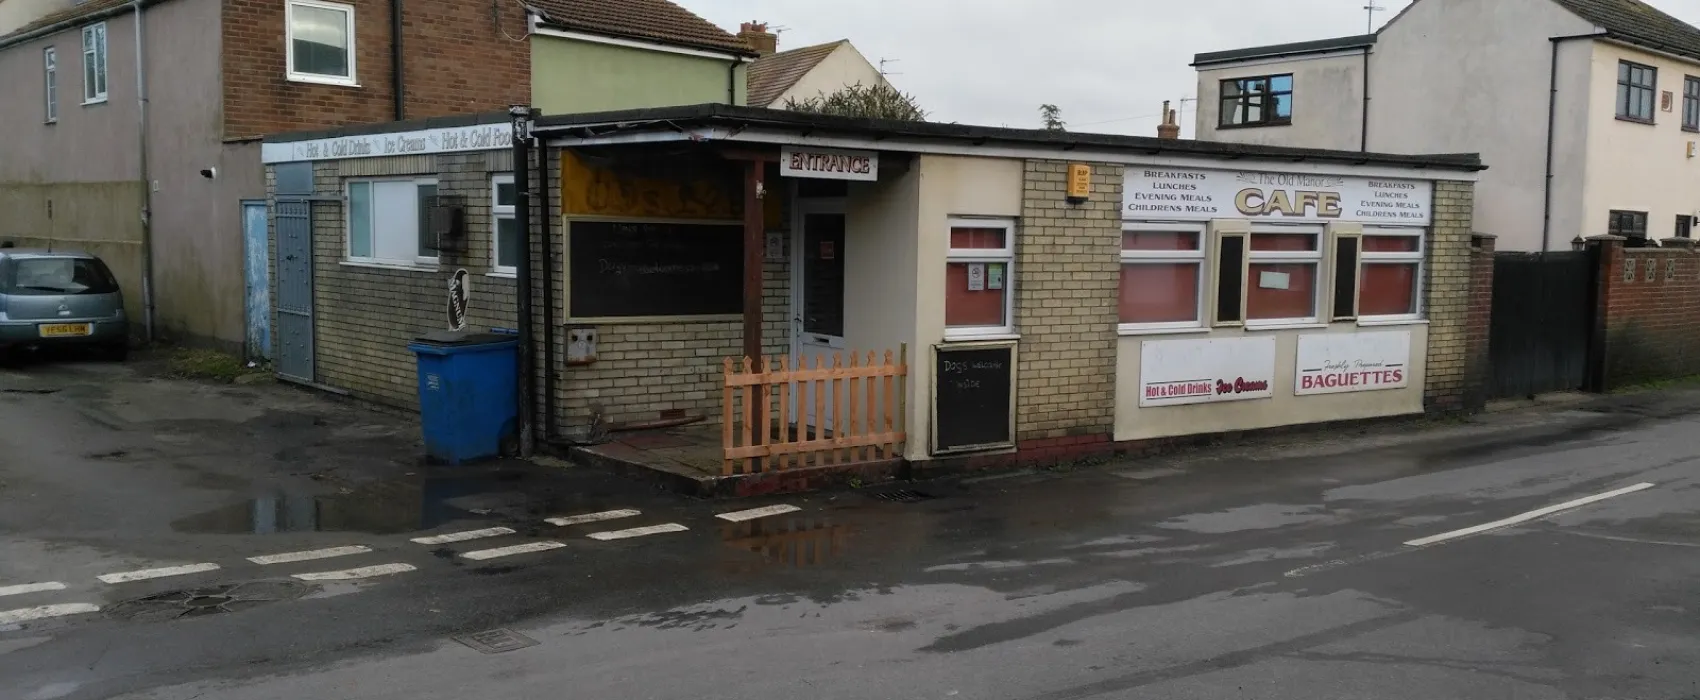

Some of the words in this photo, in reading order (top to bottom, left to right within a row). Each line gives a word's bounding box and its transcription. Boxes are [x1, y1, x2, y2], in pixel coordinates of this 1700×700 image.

[384, 137, 395, 153] Ice
[399, 135, 425, 153] Creams
[442, 132, 458, 150] Hot
[460, 132, 467, 148] &
[470, 128, 491, 148] Cold
[306, 142, 319, 158] Hot
[323, 142, 328, 157] &
[331, 139, 347, 156] Cold
[349, 138, 370, 155] Drinks
[789, 152, 870, 174] ENTRANCE
[1143, 170, 1206, 180] BREAKFASTS
[1260, 173, 1275, 185] The
[1278, 175, 1294, 187] Old
[1297, 175, 1325, 188] Manor
[1152, 182, 1197, 191] LUNCHES
[1368, 181, 1416, 190] BREAKFASTS
[1135, 192, 1177, 201] EVENING
[1180, 194, 1212, 202] MEALS
[1234, 187, 1342, 218] CAFE
[1374, 191, 1408, 199] LUNCHES
[1128, 203, 1182, 212] CHILDRENS
[1185, 205, 1217, 213] MEALS
[1360, 200, 1394, 208] EVENING
[1356, 209, 1397, 218] CHILDRENS
[1399, 211, 1424, 219] MEALS
[1216, 379, 1233, 395] Ice
[1234, 376, 1268, 394] Creams
[1301, 369, 1403, 389] BAGUETTES
[1145, 385, 1159, 397] Hot
[1161, 387, 1167, 395] &
[1168, 384, 1185, 395] Cold
[1187, 382, 1212, 394] Drinks
